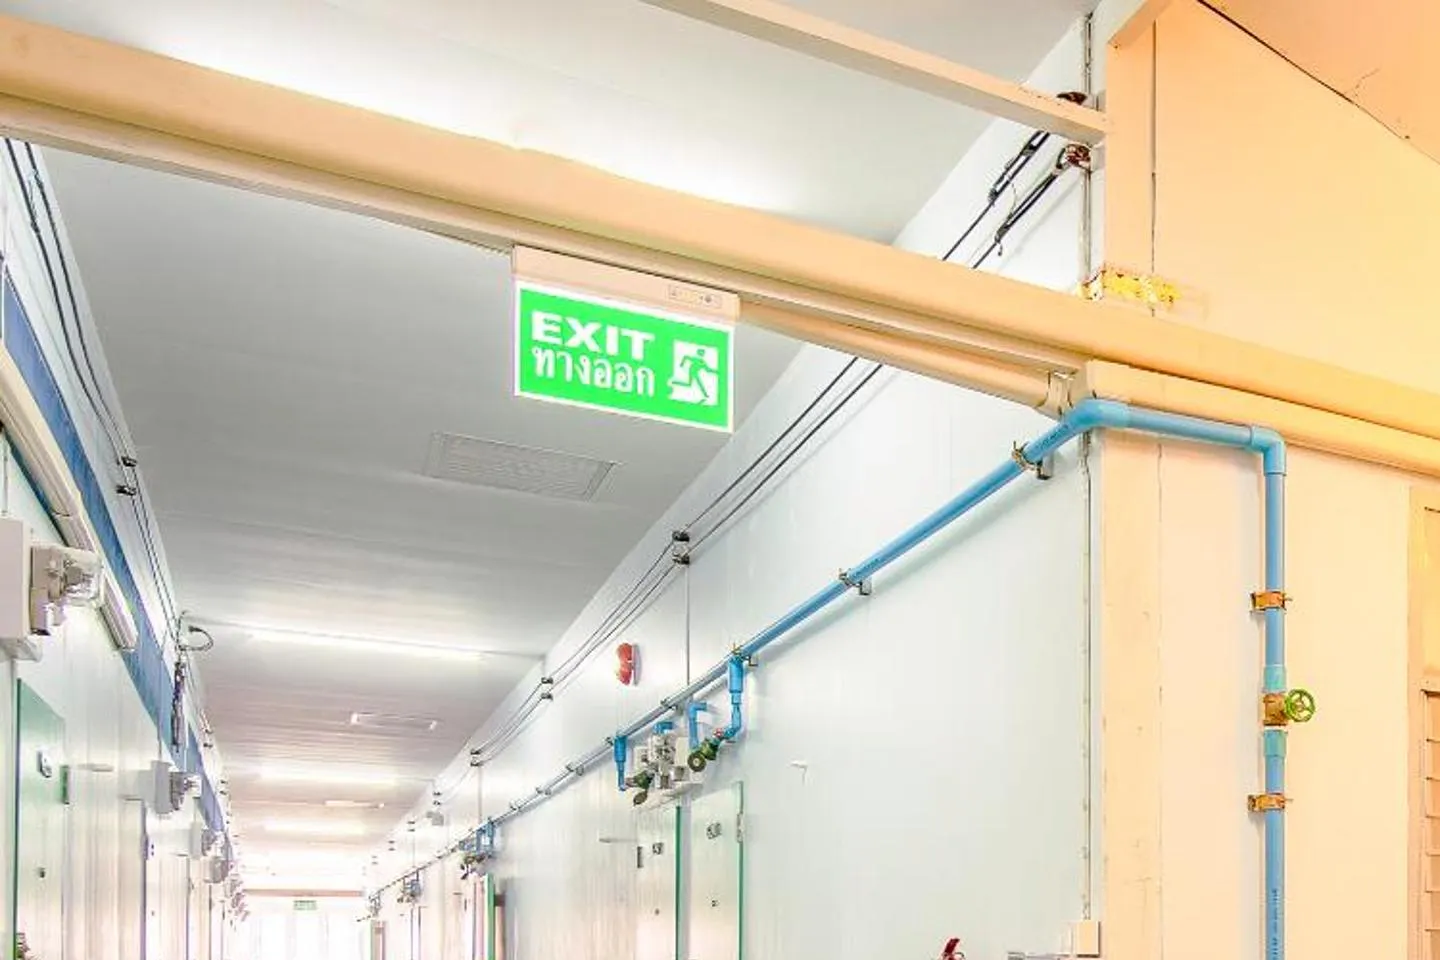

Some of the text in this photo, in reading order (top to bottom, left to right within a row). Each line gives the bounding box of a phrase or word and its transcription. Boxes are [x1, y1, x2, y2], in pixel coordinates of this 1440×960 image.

[531, 310, 655, 360] EXIT
[531, 346, 655, 397] ทางออก
